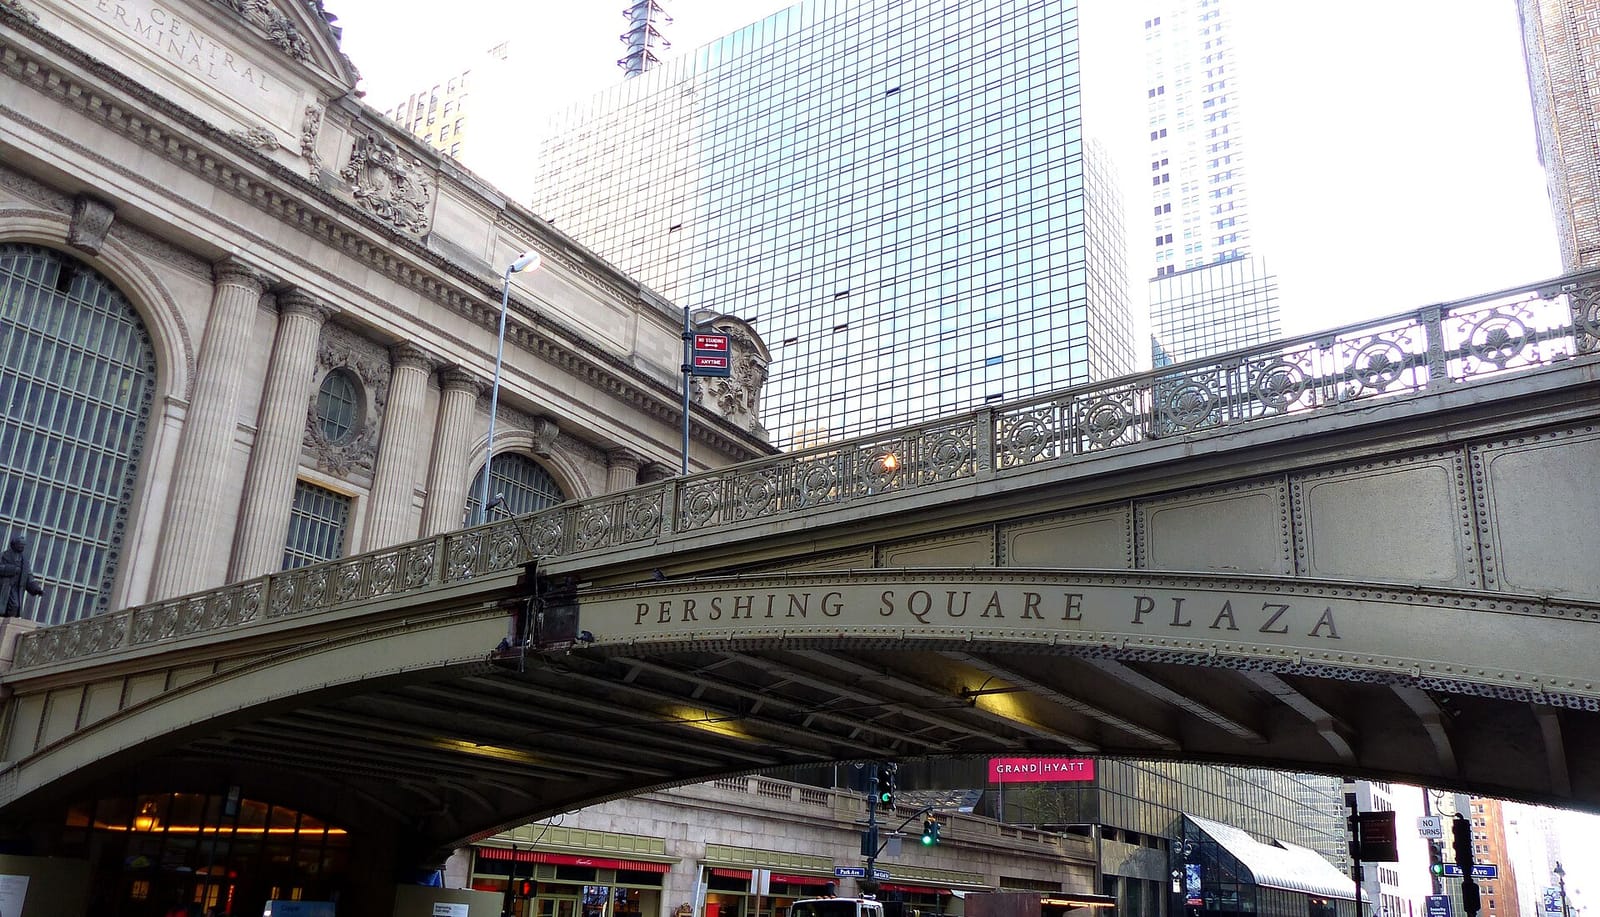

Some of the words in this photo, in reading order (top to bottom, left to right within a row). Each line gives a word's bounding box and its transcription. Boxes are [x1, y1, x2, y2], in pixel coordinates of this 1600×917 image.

[96, 0, 217, 80] ERMINAL
[150, 8, 270, 92] CENTRAL
[634, 592, 844, 625] PERSHING
[879, 590, 1083, 624] SQUARE
[1131, 595, 1341, 639] PLAZA
[996, 764, 1037, 773] GRAND
[1044, 762, 1084, 772] HYATT
[1422, 819, 1433, 827] NO
[1418, 828, 1440, 836] TURNS
[1472, 867, 1487, 875] Ave
